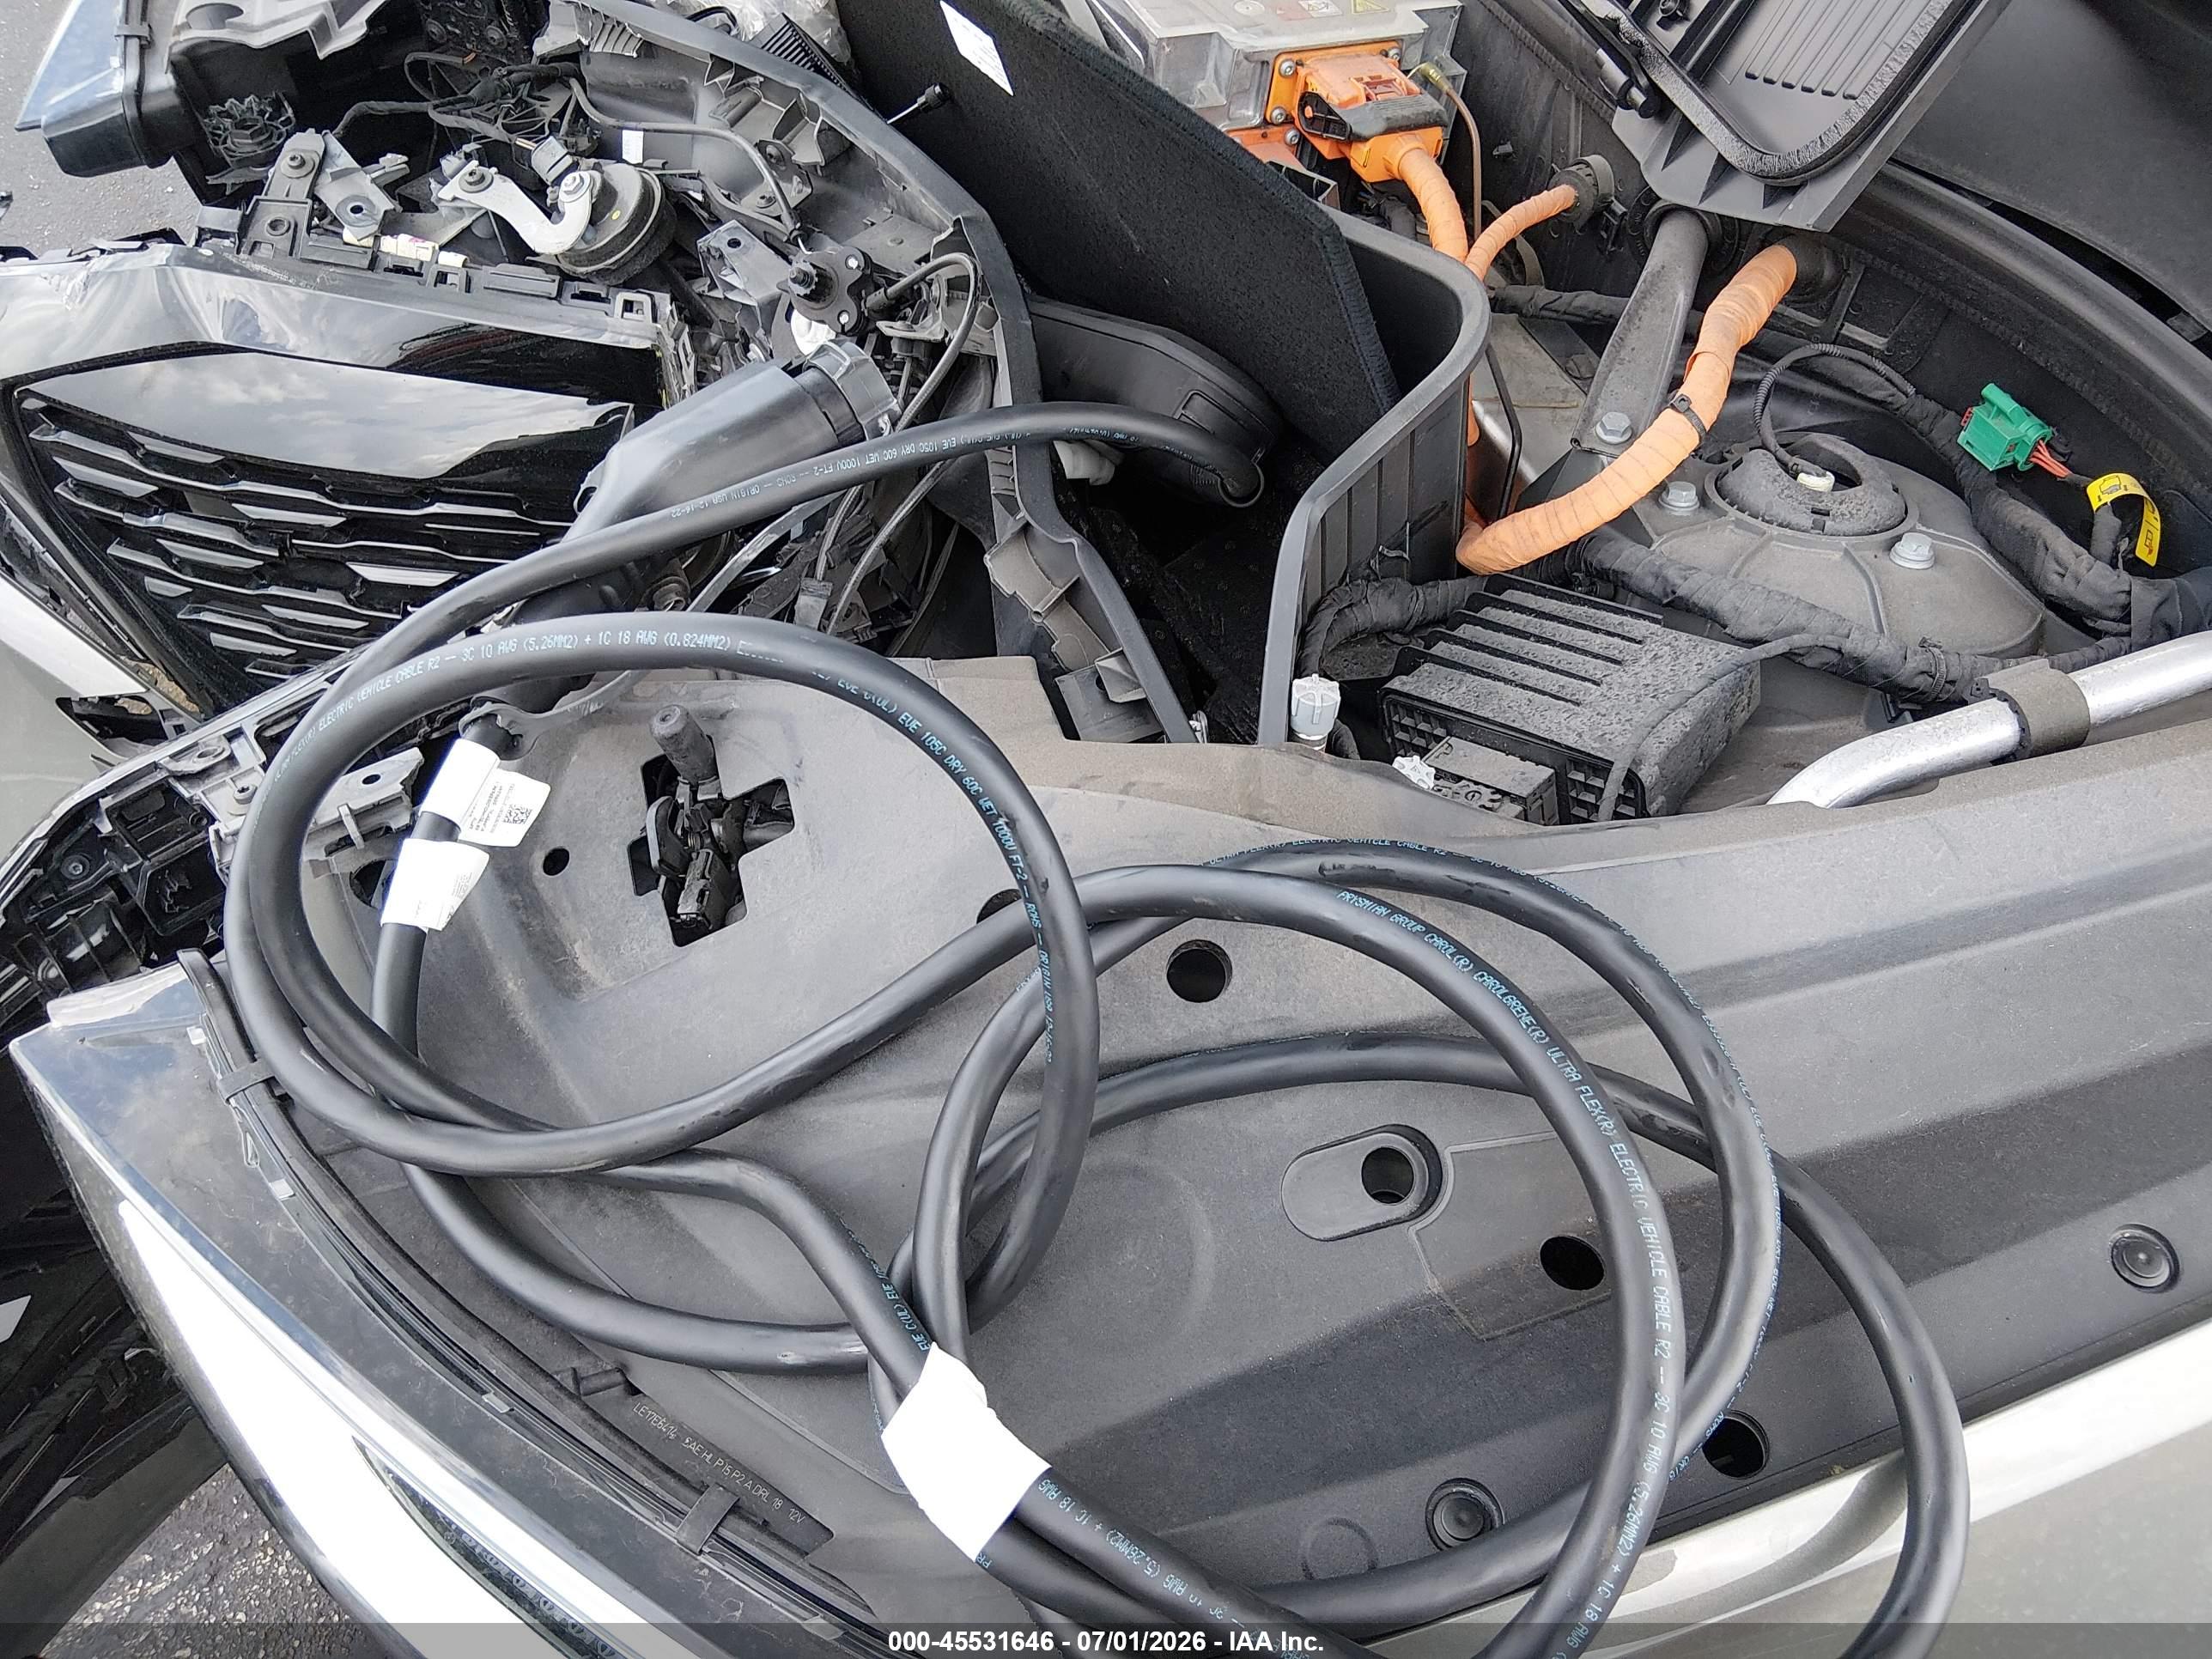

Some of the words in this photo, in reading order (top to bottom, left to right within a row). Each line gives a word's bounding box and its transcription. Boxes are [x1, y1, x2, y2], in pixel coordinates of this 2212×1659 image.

[865, 453, 881, 465] WET
[883, 450, 898, 461] 60C
[901, 445, 916, 459] DRY
[919, 441, 938, 453] 105C
[812, 465, 834, 476] FT-2
[712, 493, 728, 505] USA
[319, 696, 355, 732] ELECTRIC
[356, 675, 393, 703] VEHICLE
[396, 660, 424, 684] CABLE
[428, 656, 441, 670] R2
[480, 642, 493, 659] 10
[497, 640, 518, 656] AWG
[599, 631, 611, 646] 1C
[617, 630, 630, 646] 18
[635, 630, 659, 647] AWG
[921, 731, 948, 757] 105C
[943, 754, 968, 775] DRY
[962, 775, 984, 797] 60C
[977, 795, 998, 818] WET
[1008, 853, 1029, 881] FT-2
[1025, 902, 1042, 930] ROHS
[1336, 890, 1390, 917] PRYSMIAN
[1389, 912, 1426, 933] GROUP
[1424, 933, 1474, 972] CAROL(R)
[1546, 1045, 1582, 1083] ULTRA
[1575, 1085, 1619, 1138] FLEX(R)
[1609, 1142, 1650, 1210] ELECTRIC
[1637, 1216, 1668, 1279] VEHICLE
[1652, 1285, 1672, 1334] CABLE
[1653, 1336, 1671, 1360] R2
[1653, 1391, 1671, 1413] 3C
[1649, 1418, 1668, 1441] 10
[1642, 1443, 1664, 1475] AWG
[1669, 1456, 1691, 1480] ORIG
[744, 1480, 753, 1491] A
[752, 1484, 771, 1504] DRL
[772, 1497, 784, 1511] 18
[788, 1508, 807, 1524] 12V
[1059, 1496, 1076, 1511] 18
[1163, 1574, 1189, 1597] AWG
[1595, 1578, 1616, 1601] 1C
[1585, 1600, 1604, 1624] 18
